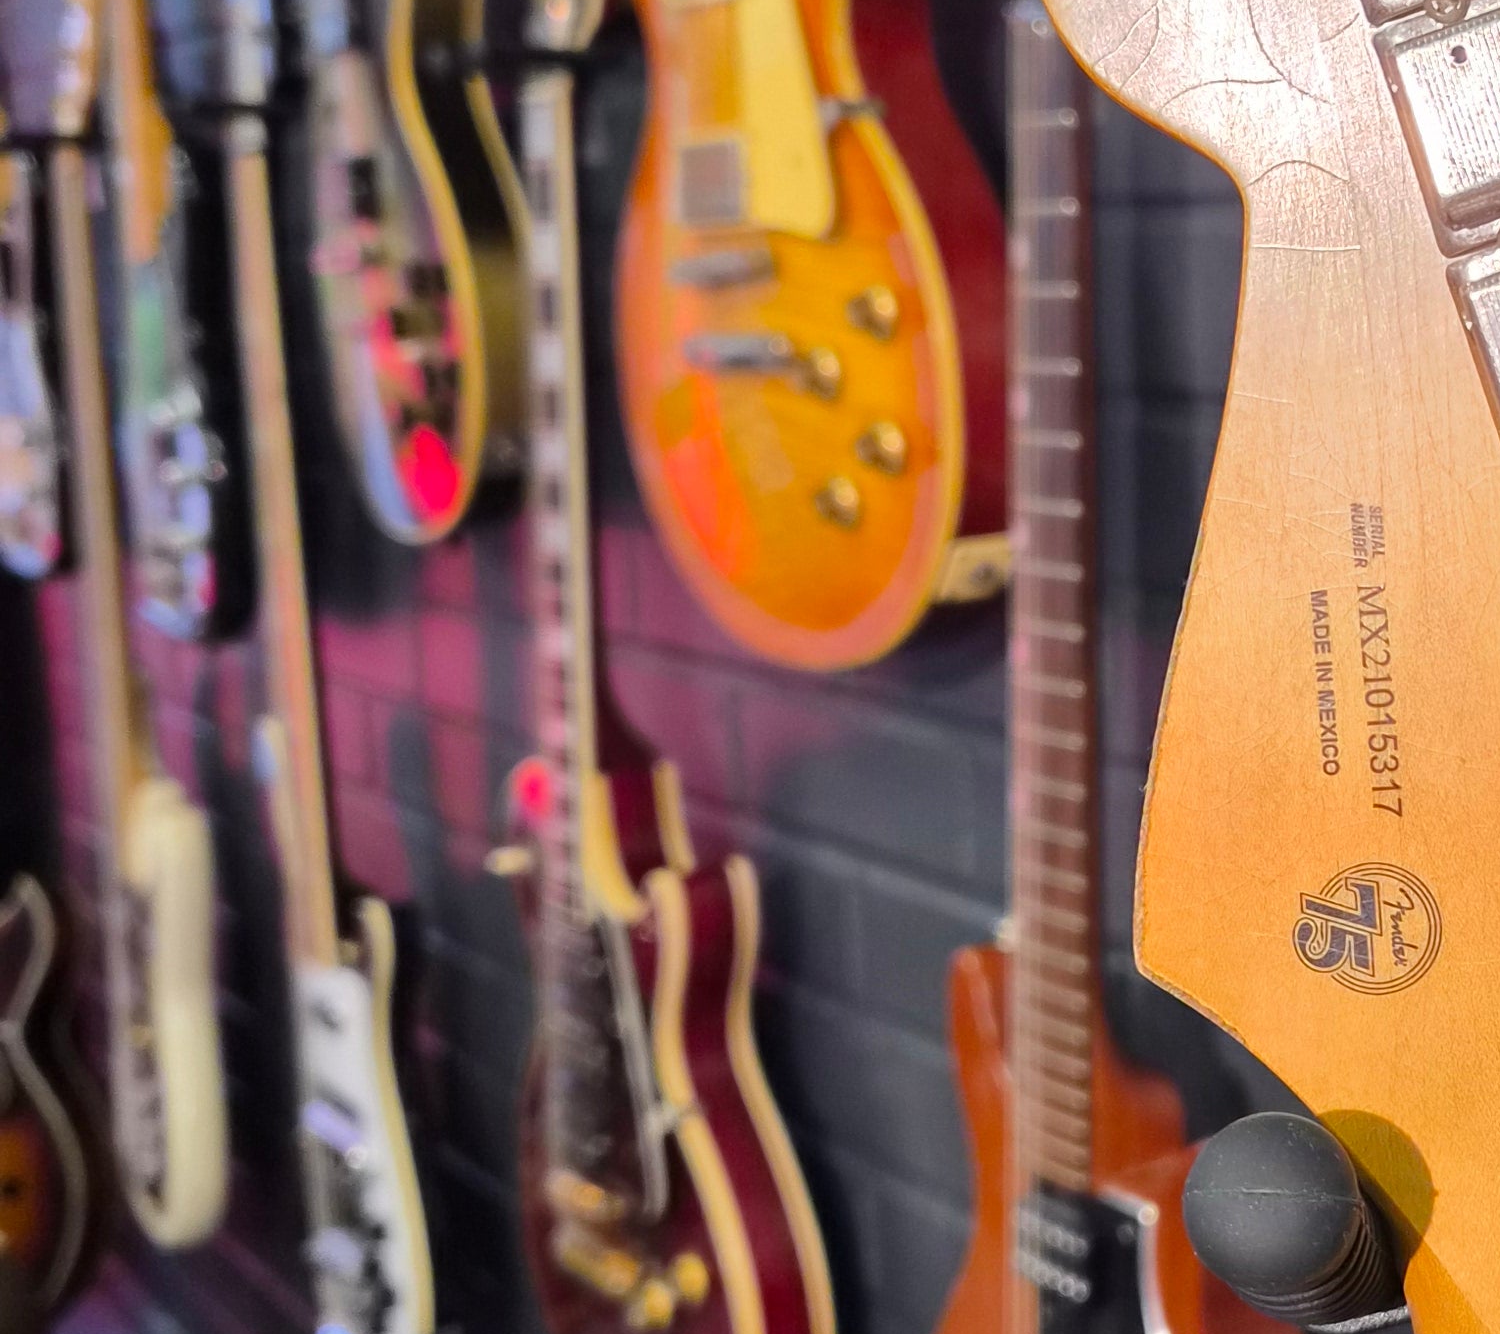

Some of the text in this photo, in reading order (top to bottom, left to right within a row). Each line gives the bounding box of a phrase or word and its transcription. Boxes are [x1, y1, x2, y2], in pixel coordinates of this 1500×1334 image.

[1350, 502, 1368, 569] NUMBER
[1368, 505, 1385, 559] SERIAL
[1310, 589, 1341, 777] MADE IN MEXICO
[1357, 582, 1403, 818] MX21015317
[1293, 877, 1382, 977] 75
[1383, 886, 1418, 968] Fender
